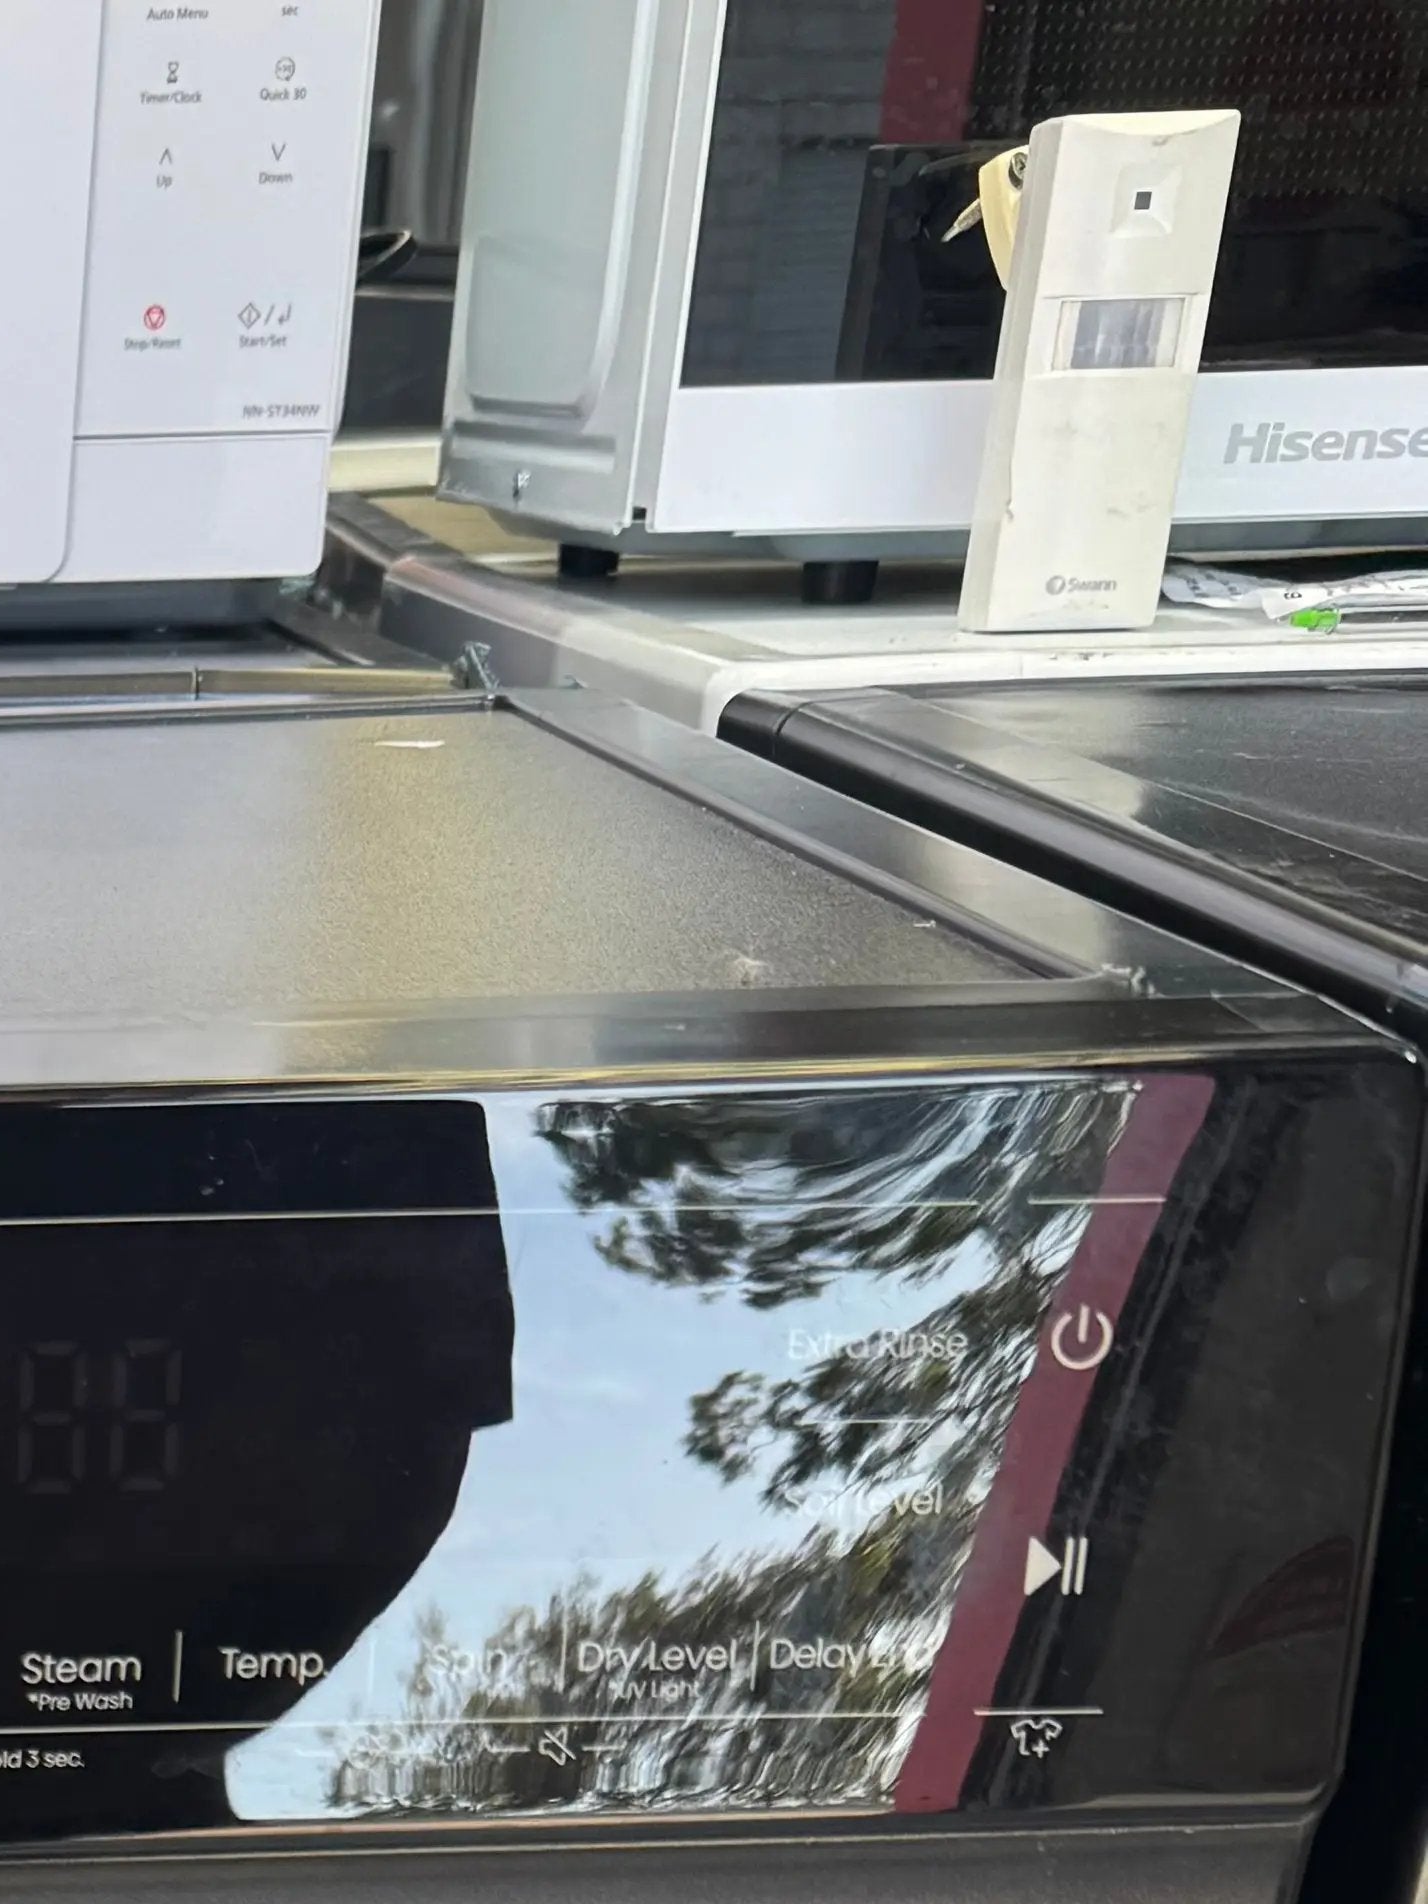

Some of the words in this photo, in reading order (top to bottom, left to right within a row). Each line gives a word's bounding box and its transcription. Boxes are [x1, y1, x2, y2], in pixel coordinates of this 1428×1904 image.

[147, 8, 174, 20] Auto
[177, 8, 208, 20] Menu
[1223, 421, 1428, 465] Hisense
[1067, 577, 1117, 594] Swann
[20, 1651, 143, 1686] Steam
[217, 1645, 331, 1687] Temp.
[578, 1640, 636, 1676] Dry
[646, 1637, 738, 1673] Level
[770, 1637, 866, 1678] Delay
[73, 1690, 134, 1711] Wash
[25, 1749, 40, 1769] 3
